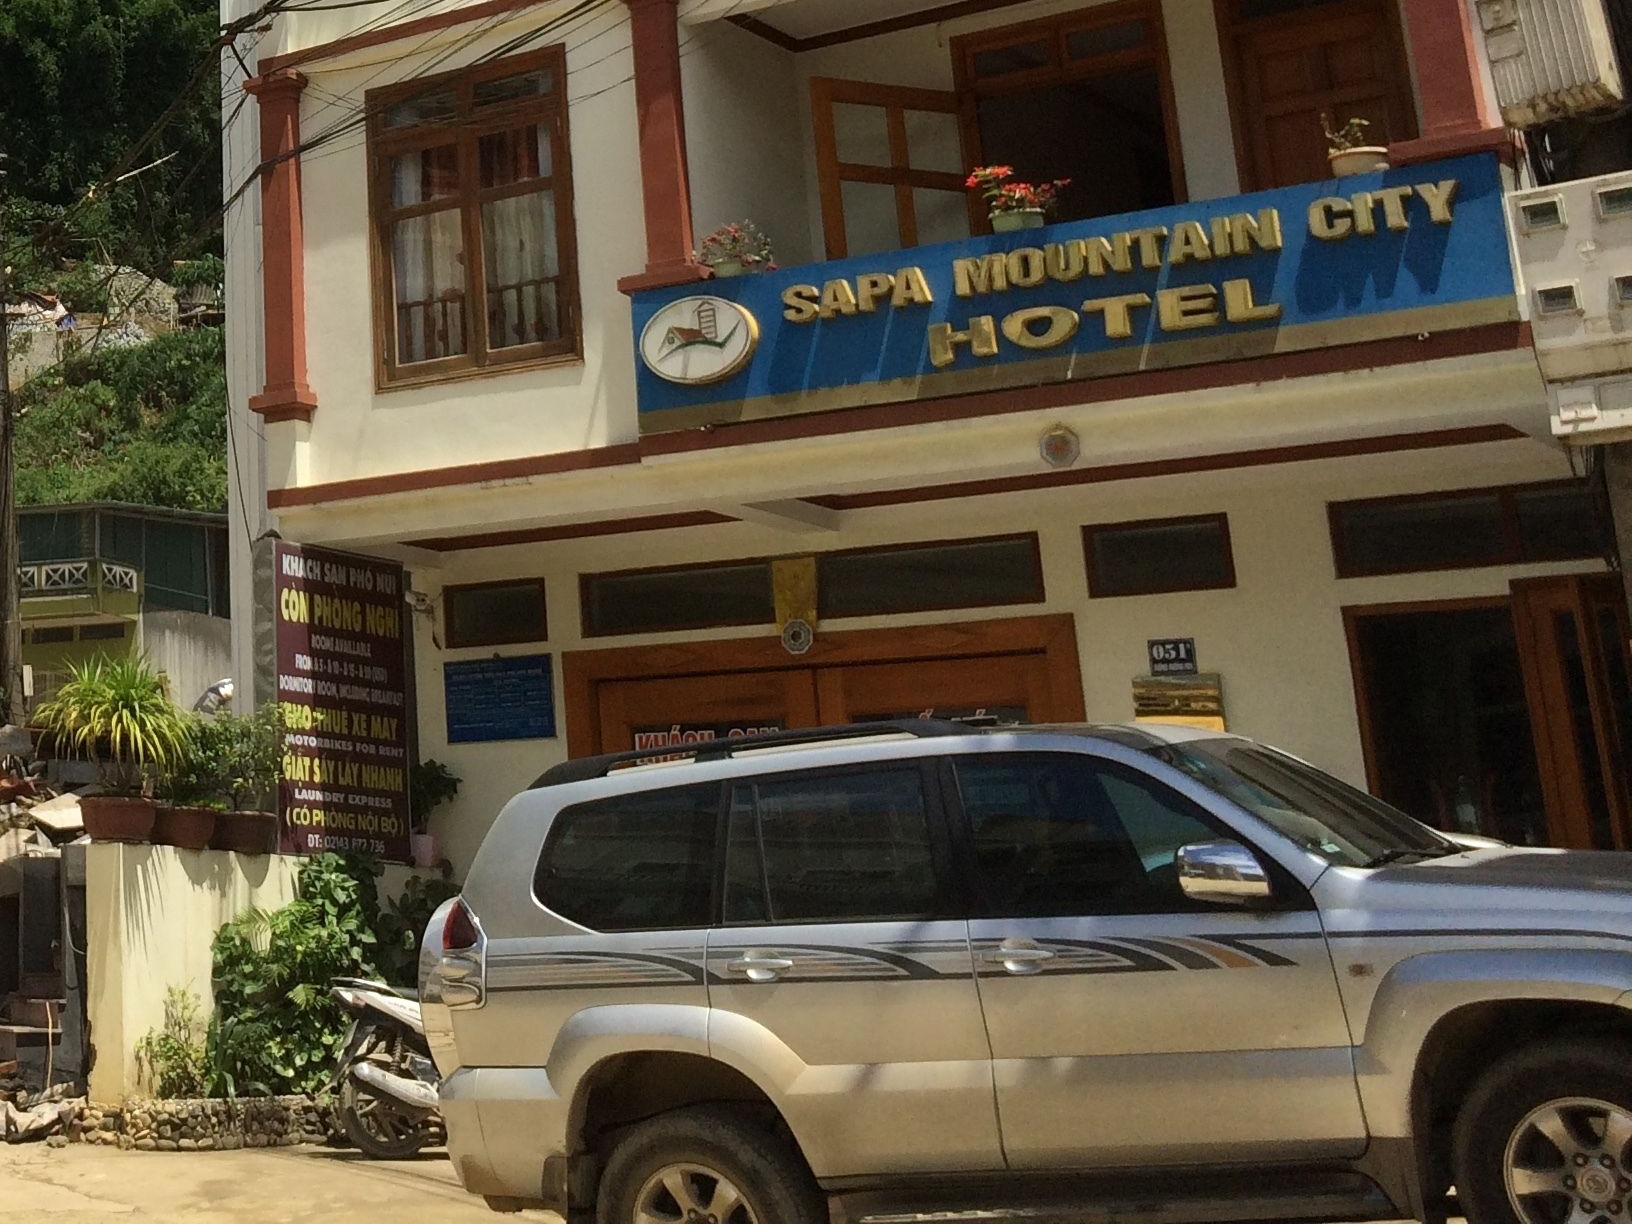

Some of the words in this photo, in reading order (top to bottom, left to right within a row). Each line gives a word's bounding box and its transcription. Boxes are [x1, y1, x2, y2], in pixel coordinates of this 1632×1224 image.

[781, 266, 934, 323] SAPA
[953, 208, 1283, 297] MOUNTAIN
[1307, 179, 1457, 241] CITY
[927, 278, 1284, 368] HOTEL
[280, 581, 310, 624] CÒN
[314, 584, 362, 632] PHÒNG
[295, 653, 313, 671] FROM
[283, 702, 312, 730] CHO
[351, 712, 368, 737] XE
[285, 733, 353, 752] MOTORBIKES
[356, 742, 376, 755] FOR
[378, 745, 404, 758] RENT
[361, 763, 403, 792] NHANH
[294, 788, 346, 804] LAUNDRY
[348, 794, 393, 809] EXPRESS
[312, 806, 356, 830] PHÒNG
